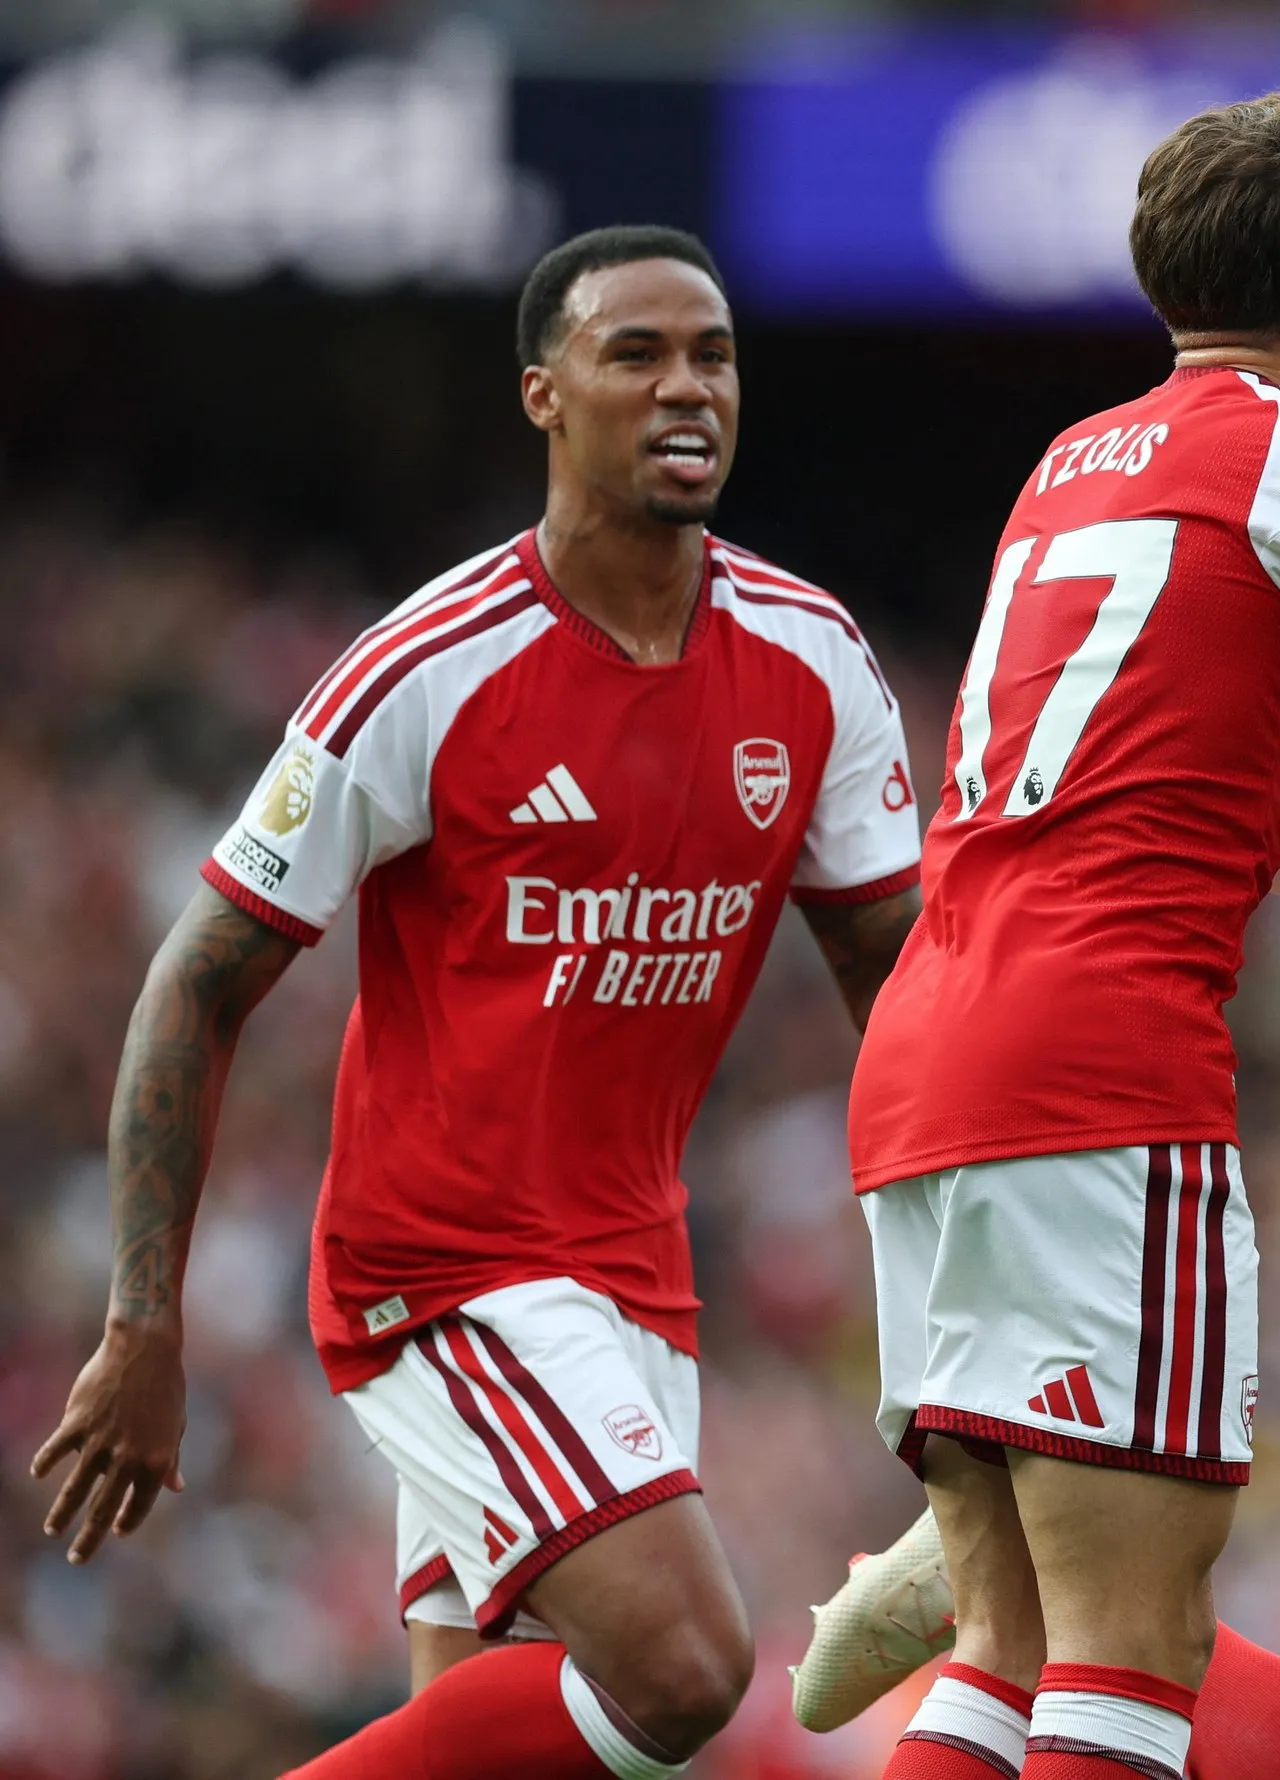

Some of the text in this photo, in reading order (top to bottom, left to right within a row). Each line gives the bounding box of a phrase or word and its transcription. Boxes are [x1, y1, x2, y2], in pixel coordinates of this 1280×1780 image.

[1035, 422, 1170, 497] TZOLIS
[952, 518, 1181, 823] 17
[241, 837, 280, 875] room
[504, 872, 763, 945] Emirates
[593, 949, 723, 1007] BETTER
